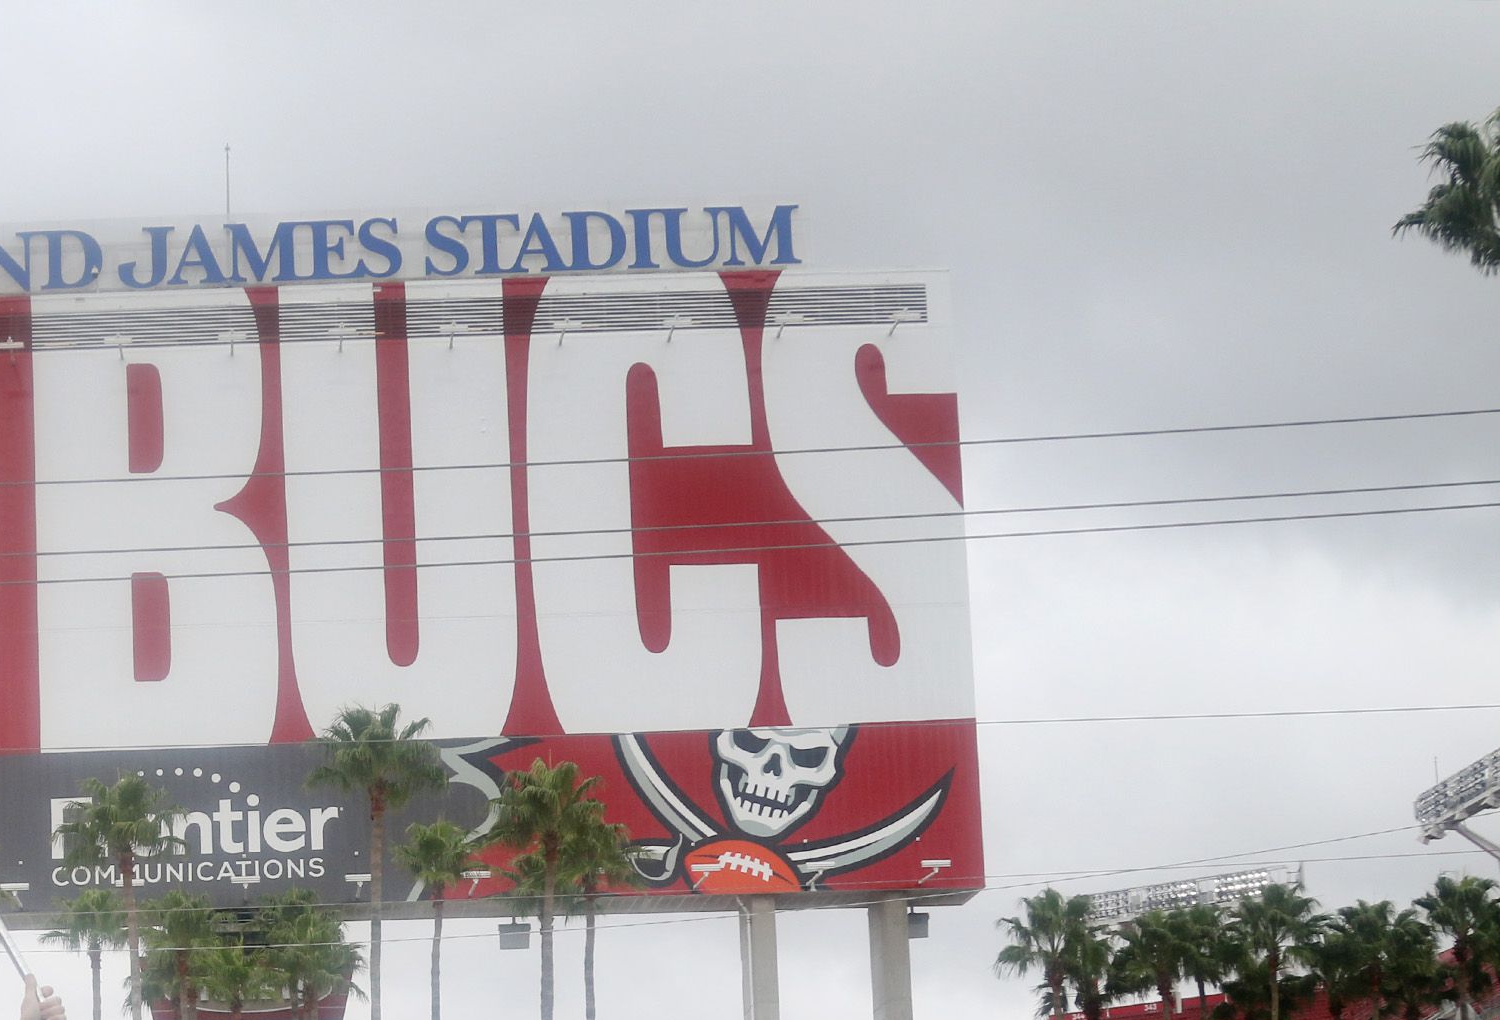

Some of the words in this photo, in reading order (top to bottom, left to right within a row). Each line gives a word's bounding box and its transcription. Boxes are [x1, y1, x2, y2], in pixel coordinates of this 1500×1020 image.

[117, 217, 403, 289] JAMES
[425, 204, 803, 277] STADIUM
[30, 270, 976, 748] BUCS
